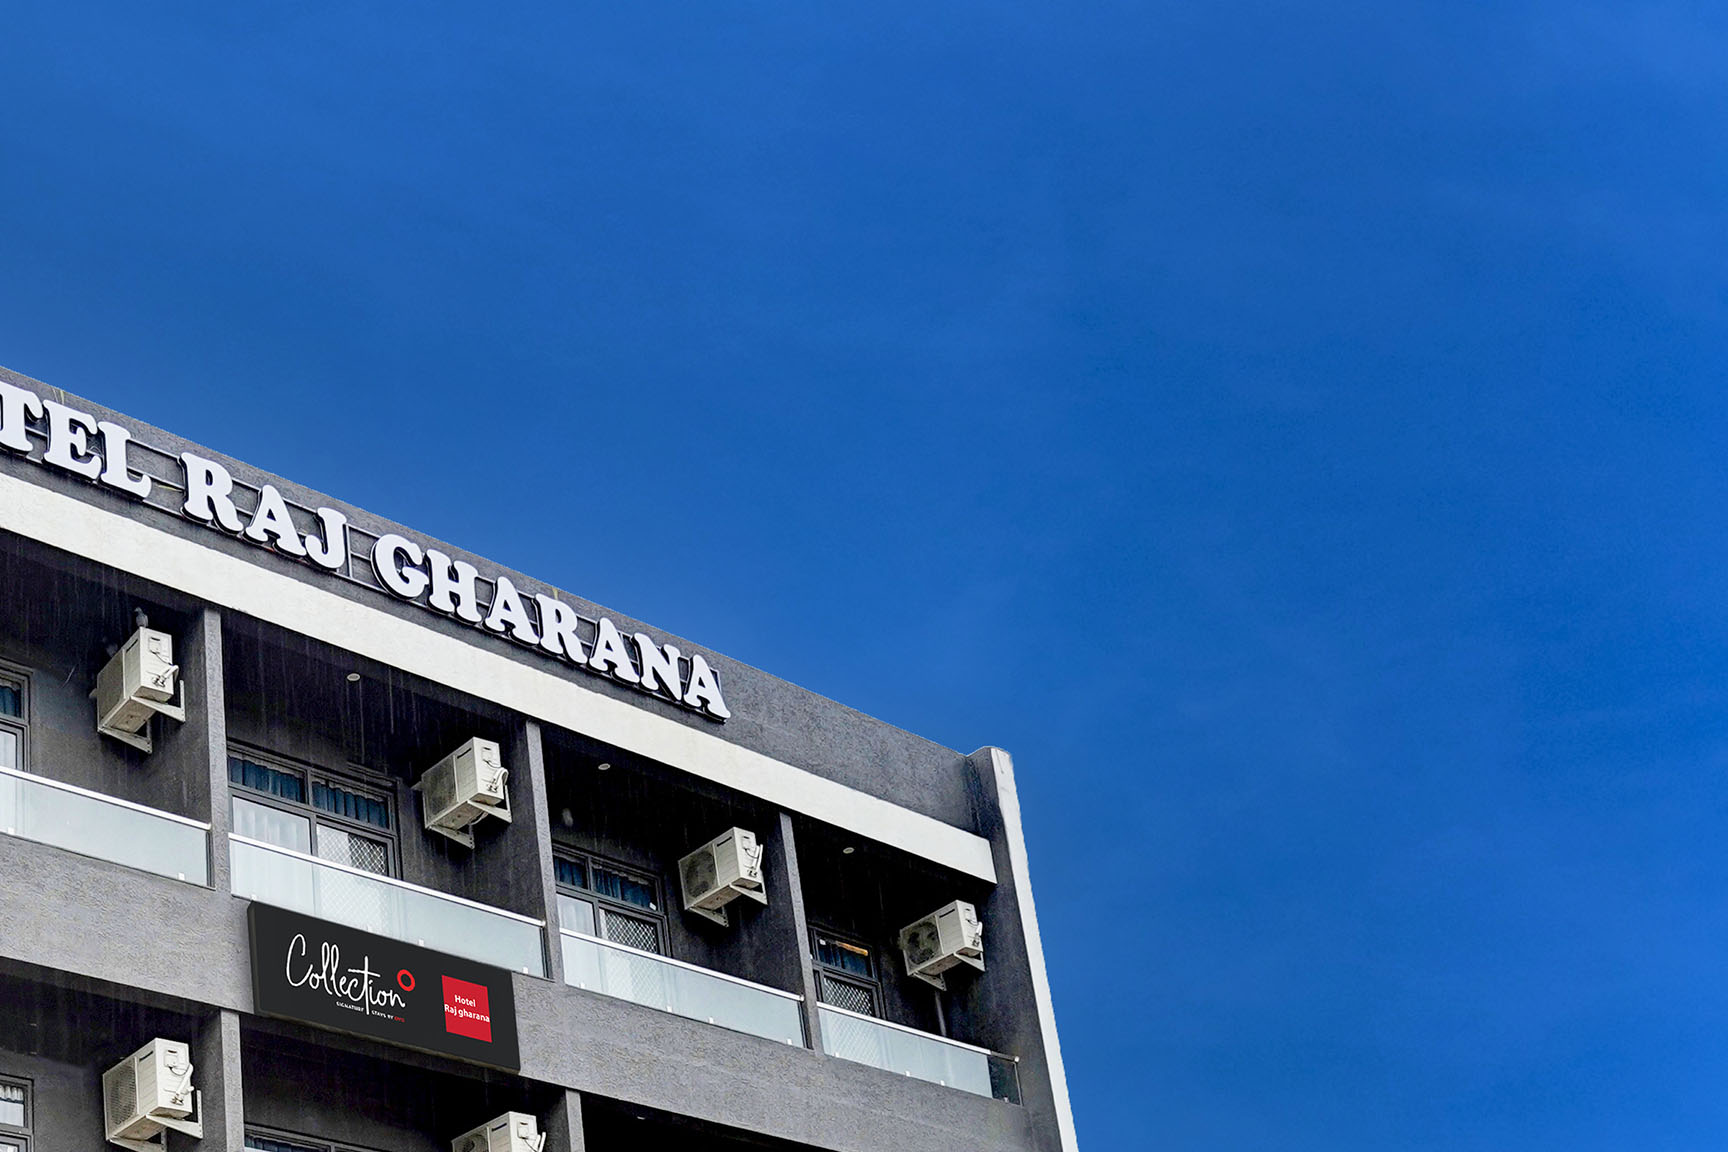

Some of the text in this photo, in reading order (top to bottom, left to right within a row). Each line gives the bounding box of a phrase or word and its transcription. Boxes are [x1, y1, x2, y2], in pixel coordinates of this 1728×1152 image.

[179, 451, 348, 572] RAJ
[371, 533, 731, 722] GHARANA
[286, 933, 406, 1015] Collection
[444, 1003, 490, 1023] Raj gharana
[454, 994, 476, 1007] Hotel
